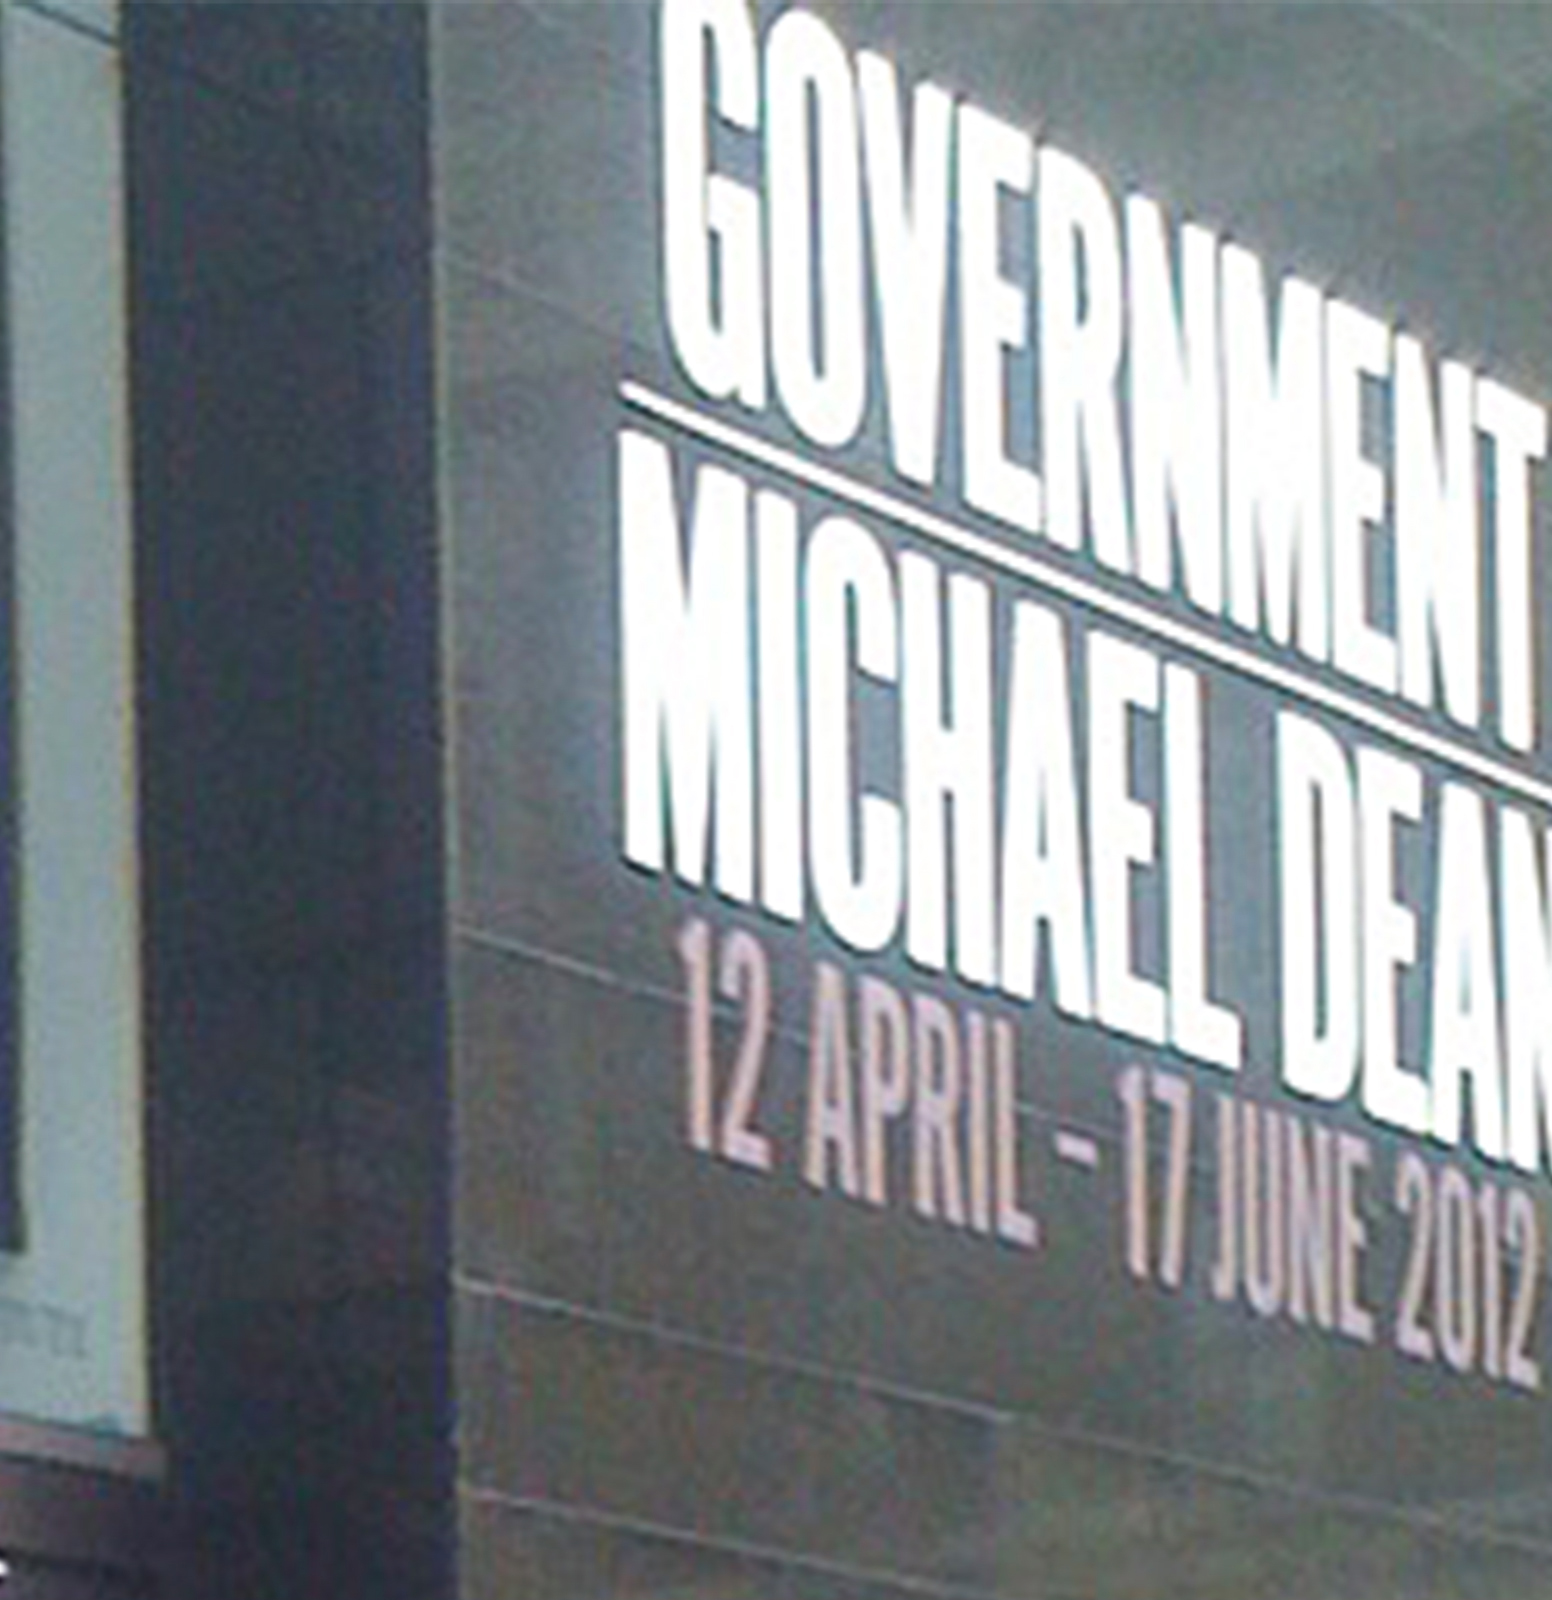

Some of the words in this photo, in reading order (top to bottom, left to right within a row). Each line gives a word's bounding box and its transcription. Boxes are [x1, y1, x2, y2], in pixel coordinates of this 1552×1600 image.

[660, 0, 1546, 754] GOVERNMENT
[618, 428, 1242, 1070] MICHAEL
[1278, 710, 1552, 1174] DEAN
[678, 920, 772, 1172] 12
[804, 960, 1038, 1250] APRIL
[1118, 1064, 1192, 1288] 17
[1212, 1096, 1376, 1342] JUNE
[1393, 1154, 1543, 1388] 2012
